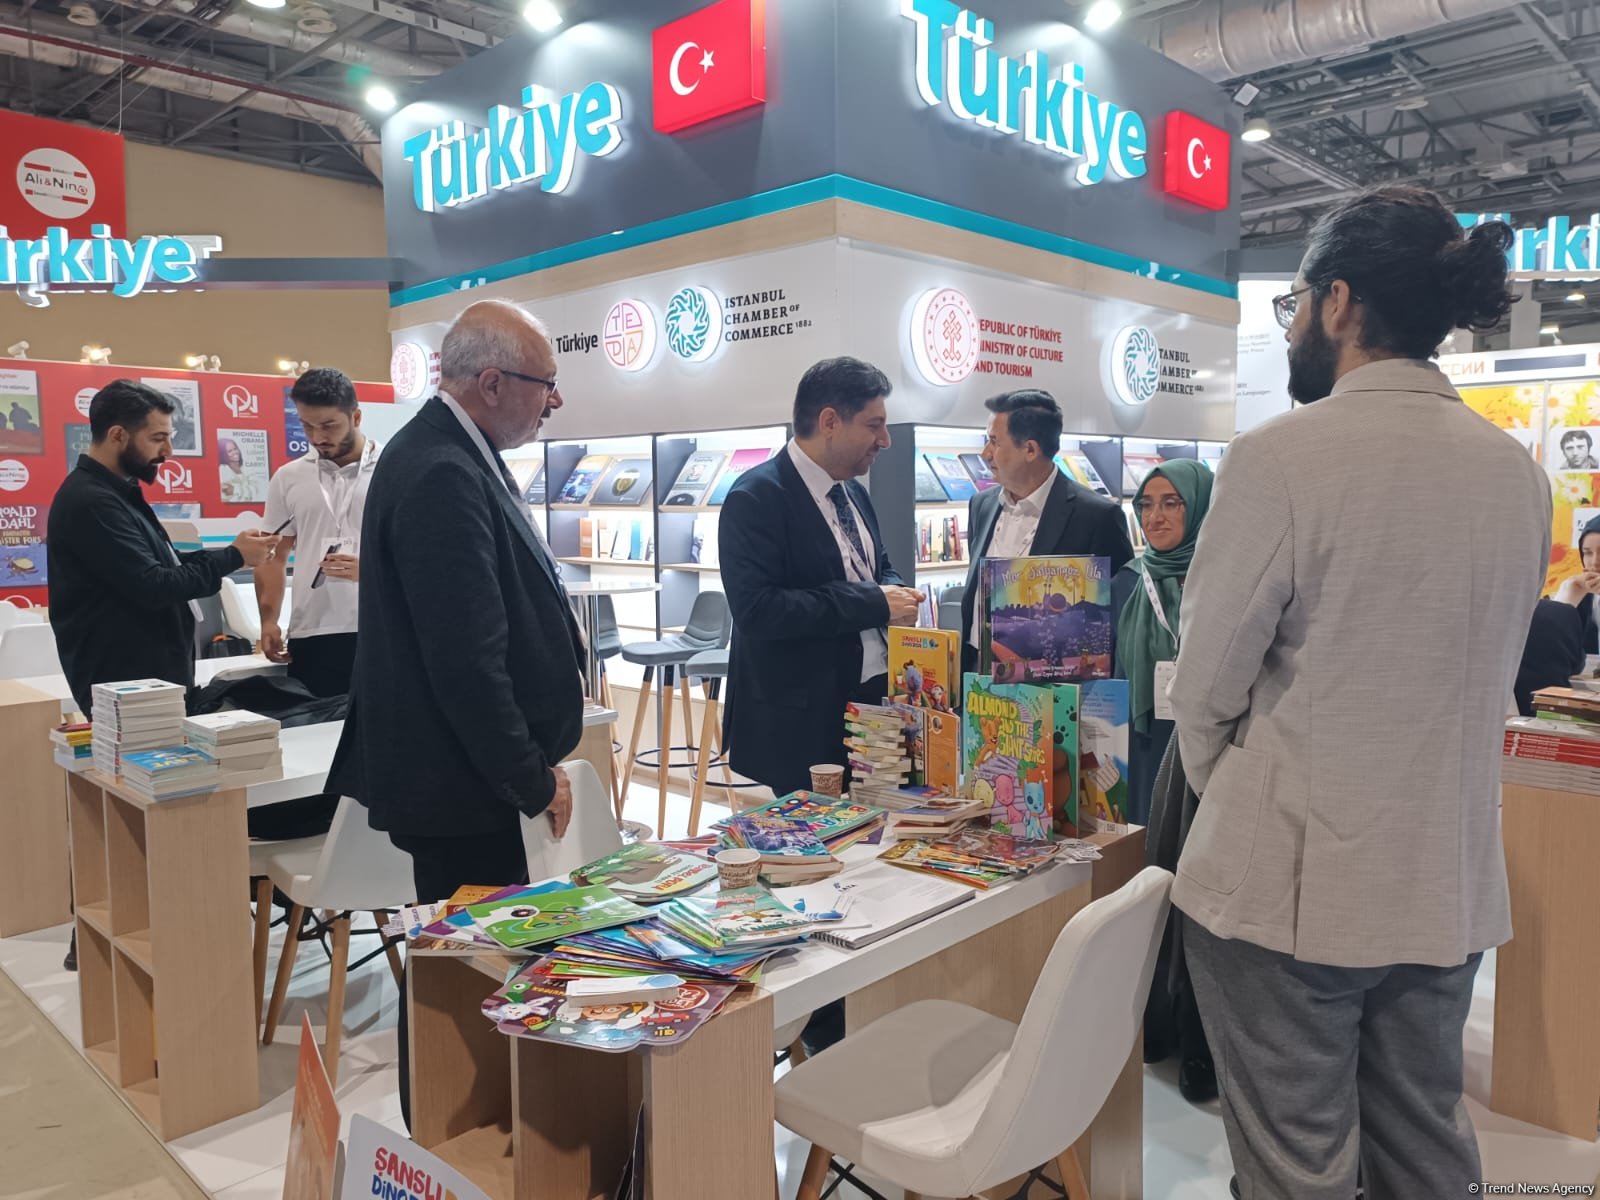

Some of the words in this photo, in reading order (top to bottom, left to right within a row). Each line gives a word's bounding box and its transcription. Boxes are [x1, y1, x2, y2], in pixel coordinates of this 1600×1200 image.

[900, 0, 1147, 186] Türkiye
[403, 81, 622, 213] Türkiye
[725, 289, 785, 309] ISTANBUL
[725, 306, 788, 326] CHAMBER
[789, 304, 801, 313] OF
[725, 322, 794, 343] COMMERCE
[977, 319, 1015, 336] EPUBLIC
[1016, 325, 1028, 338] OF
[556, 332, 598, 354] Türkiye
[979, 340, 1015, 356] INISTRY
[1016, 345, 1028, 357] OF
[1029, 347, 1063, 363] CULTURE
[1158, 348, 1191, 363] TANBUL
[974, 360, 993, 374] AND
[994, 361, 1032, 378] TOURISM
[1160, 365, 1191, 379] AMBER
[0, 517, 36, 530] DAHL
[966, 690, 1019, 721] ALMOND
[1014, 721, 1029, 739] THE
